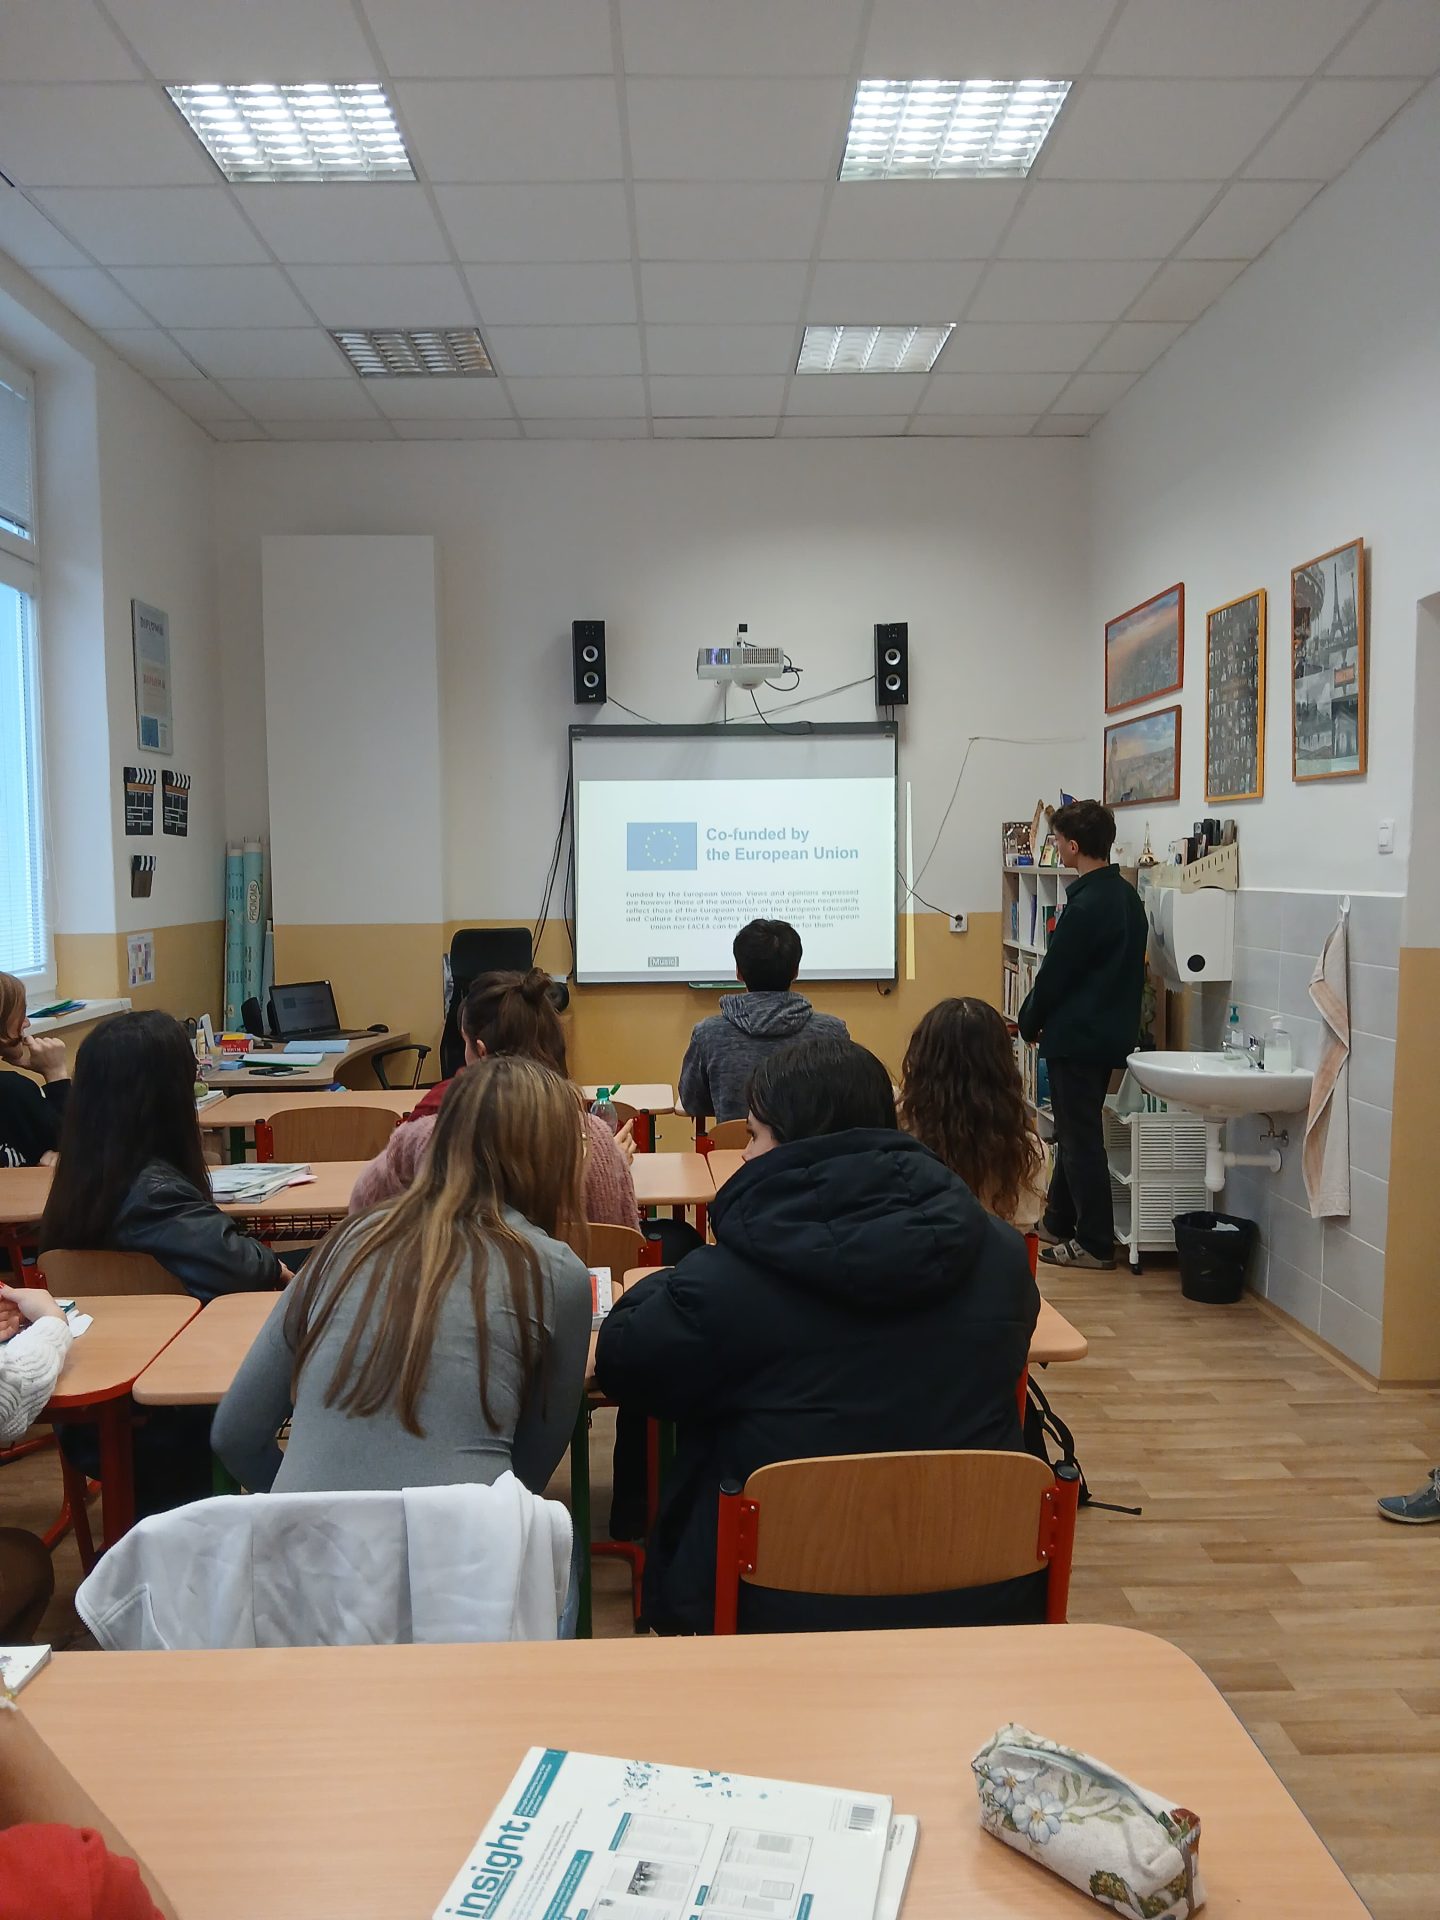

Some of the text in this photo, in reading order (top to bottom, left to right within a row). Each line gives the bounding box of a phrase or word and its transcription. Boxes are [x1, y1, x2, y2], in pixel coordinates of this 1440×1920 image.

[706, 827, 809, 843] Co-funded by
[706, 846, 859, 863] the European Union
[249, 883, 257, 921] PRONOMS
[445, 1820, 530, 1918] insight
